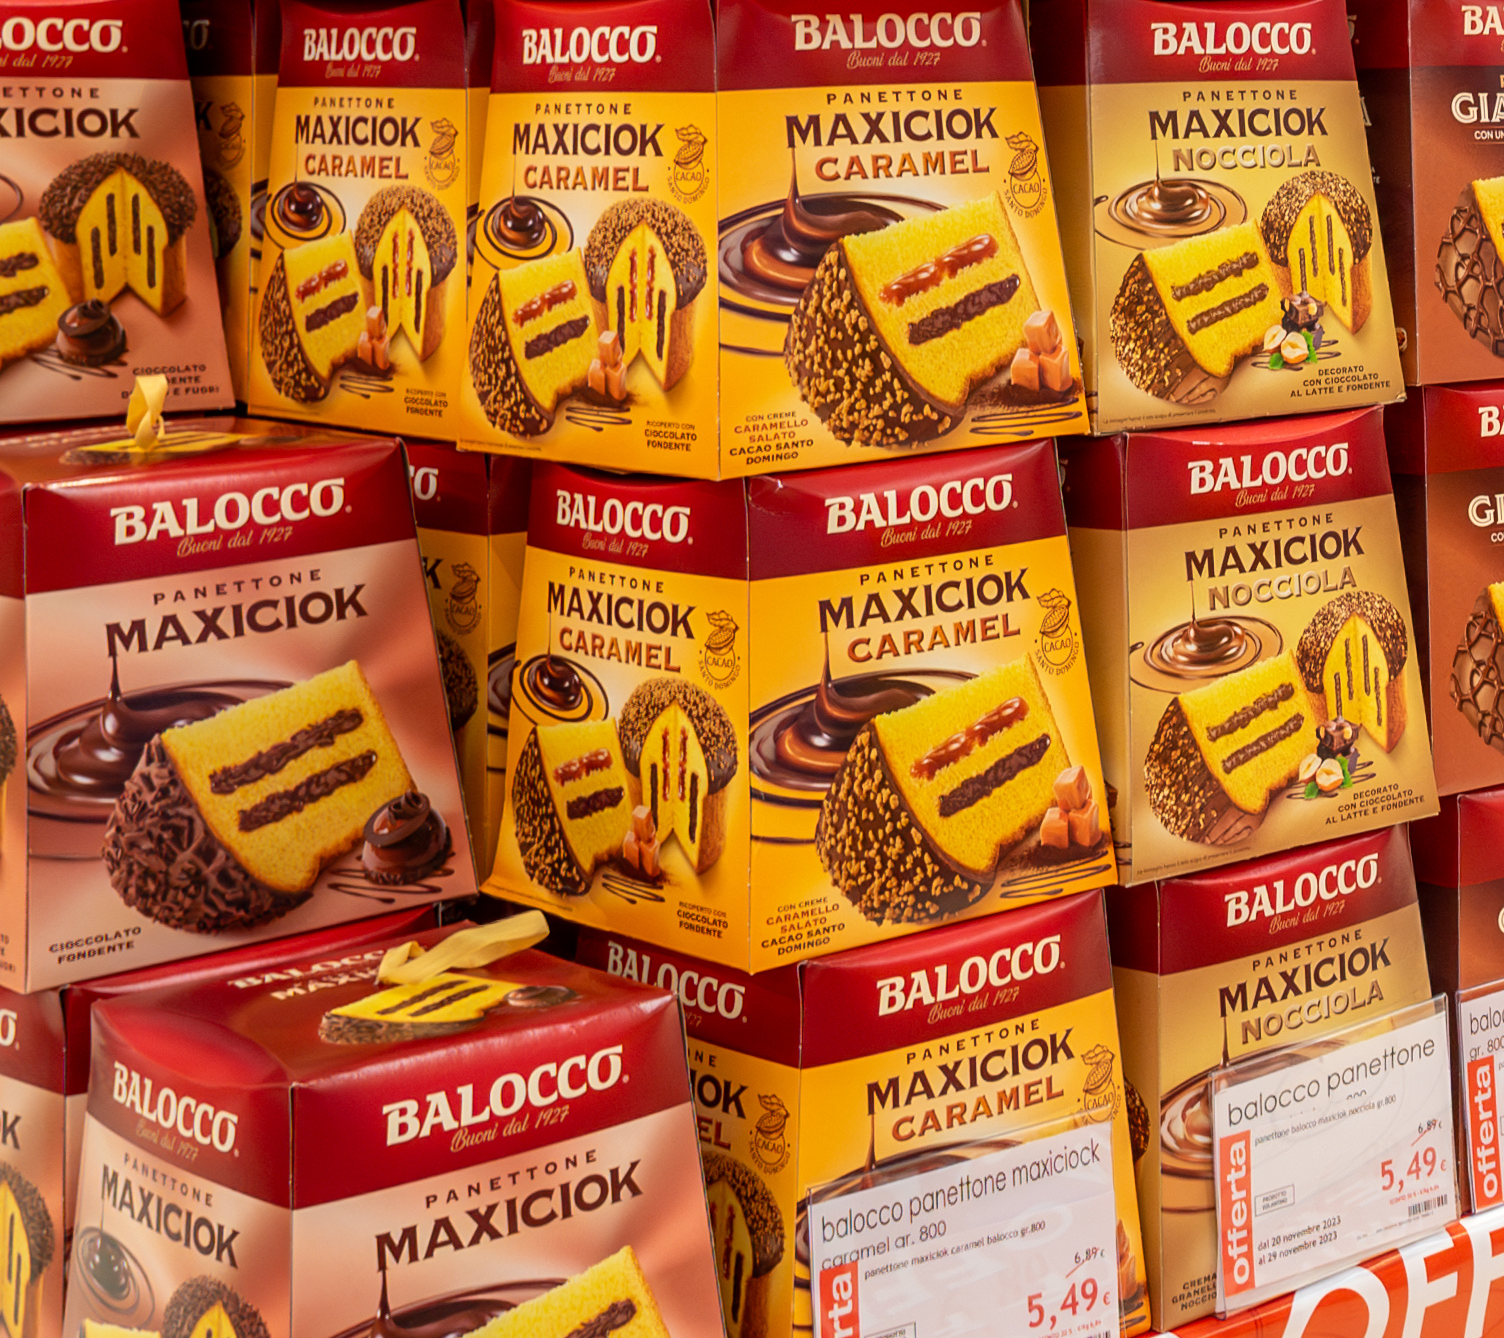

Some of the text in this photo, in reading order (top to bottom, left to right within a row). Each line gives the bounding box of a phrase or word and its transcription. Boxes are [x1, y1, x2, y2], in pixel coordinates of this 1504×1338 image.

[113, 1060, 238, 1156] BALOCCO
[382, 1045, 623, 1147] BALOCCO
[450, 1105, 569, 1154] Buoni dal 1927
[1228, 1038, 1435, 1127] balocco panettone
[1477, 1064, 1497, 1198] offerta
[101, 1163, 239, 1270] MAXICIOK
[124, 1152, 215, 1209] PANETTONE
[375, 1160, 644, 1272] MAXICIOK
[424, 1150, 598, 1210] PANETTONE
[821, 1138, 1100, 1243] balocco panettone maxiciock
[1227, 1140, 1251, 1285] offerta
